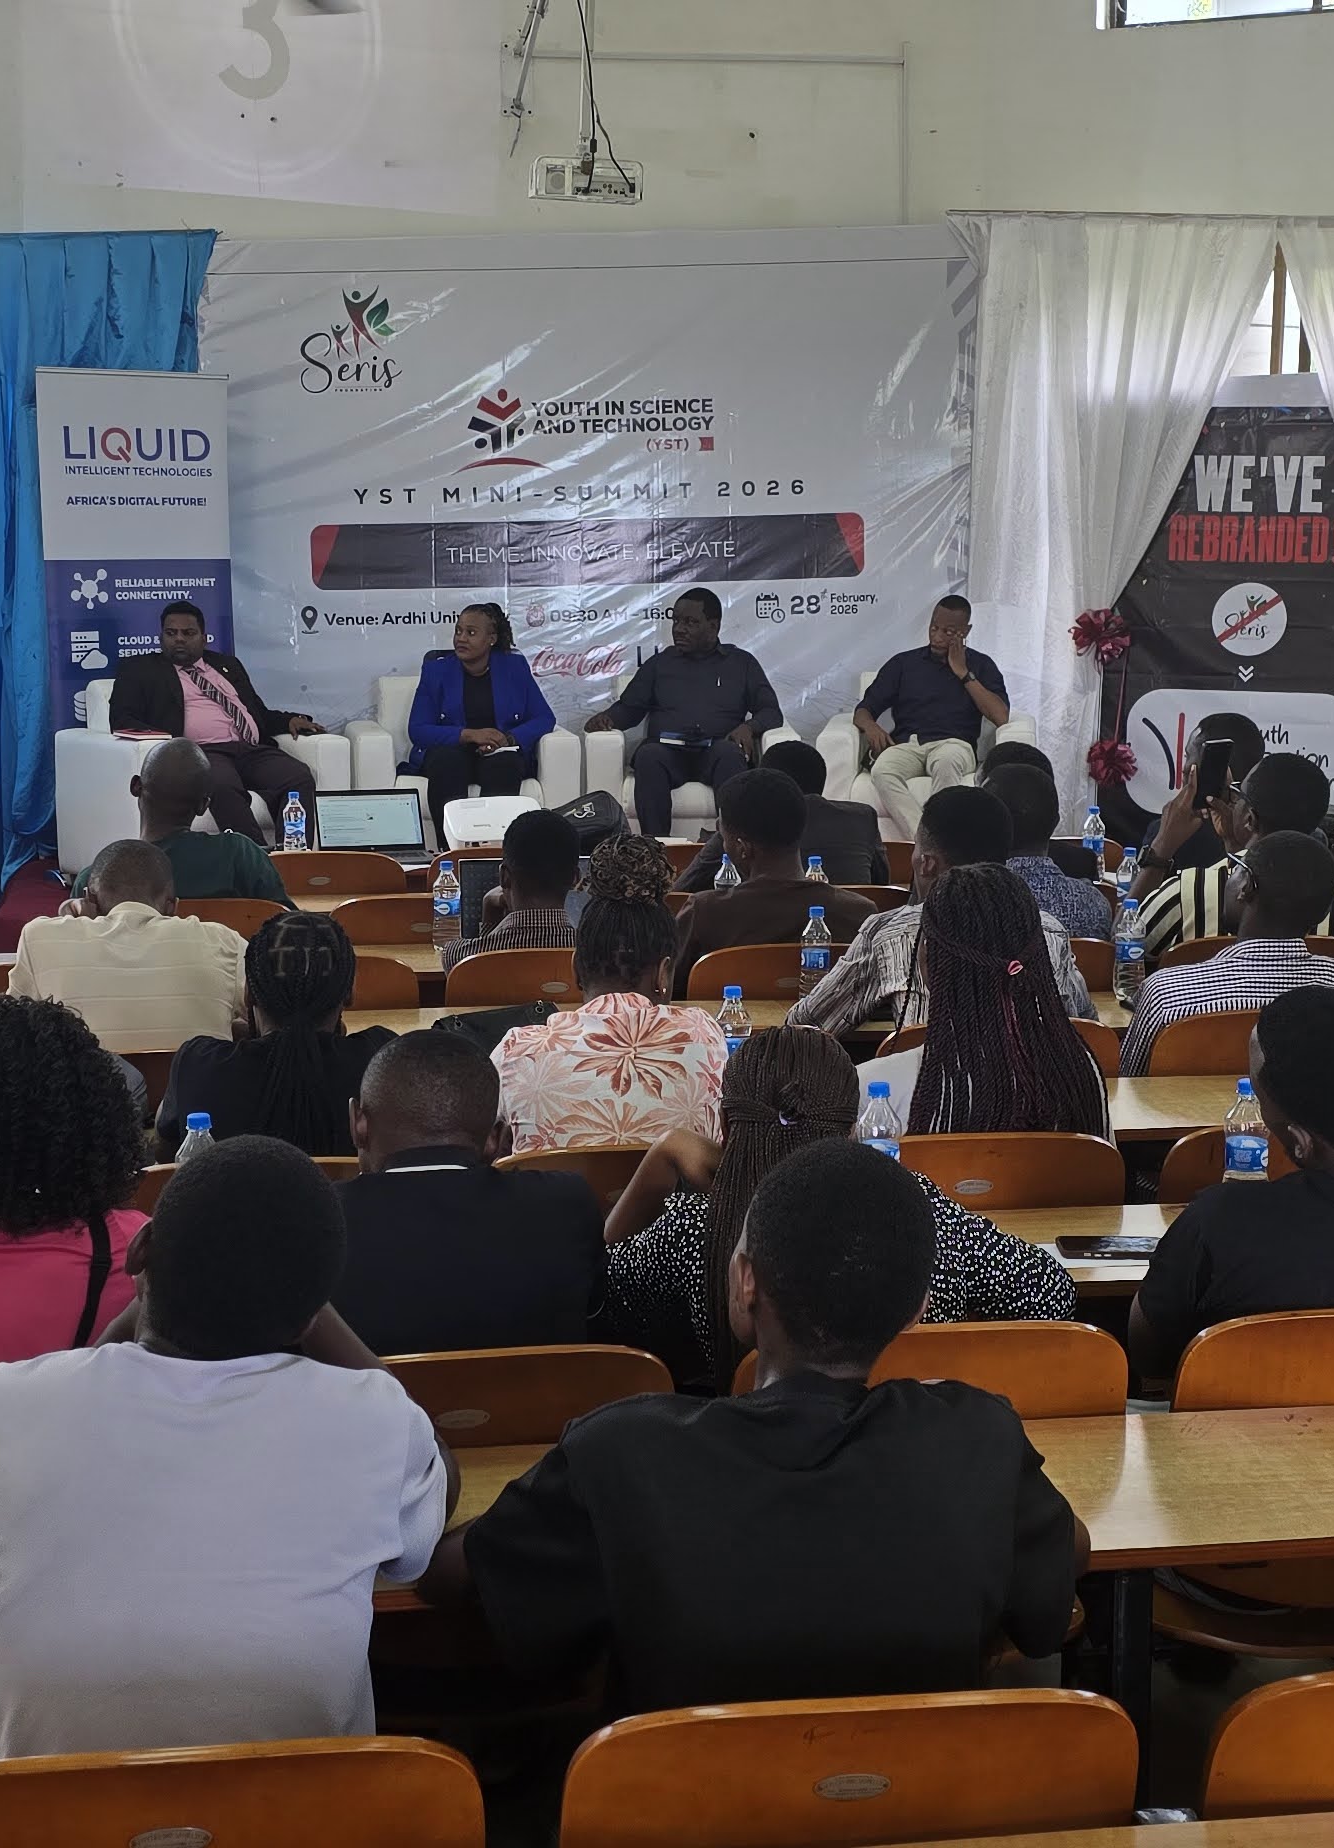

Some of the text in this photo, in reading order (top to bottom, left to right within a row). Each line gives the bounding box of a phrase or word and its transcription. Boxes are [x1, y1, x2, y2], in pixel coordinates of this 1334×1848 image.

[300, 332, 403, 394] Seris
[531, 398, 714, 417] YOUTH IN SCIENCE
[533, 416, 714, 434] AND TECHNOLOGY
[63, 425, 210, 463] LIQUID
[646, 437, 690, 452] (YST)
[65, 465, 213, 477] INTELLIGENT TECHNOLOGIES
[1194, 455, 1326, 513] WE'VE
[353, 479, 805, 504] YST MINI-SUMMIT 2026
[66, 495, 207, 507] AFRICA'S DIGITAL FUTURE!
[445, 547, 524, 563] THEME:
[646, 540, 736, 560] ELEVATE
[115, 578, 216, 588] RELIABLE INTERNET
[115, 590, 193, 600] CONNECTIVITY.
[642, 607, 674, 620] 16:0
[830, 604, 859, 615] 2026
[324, 613, 379, 625] Venue:
[382, 611, 426, 624] Ardhi
[117, 636, 152, 645] CLOUD
